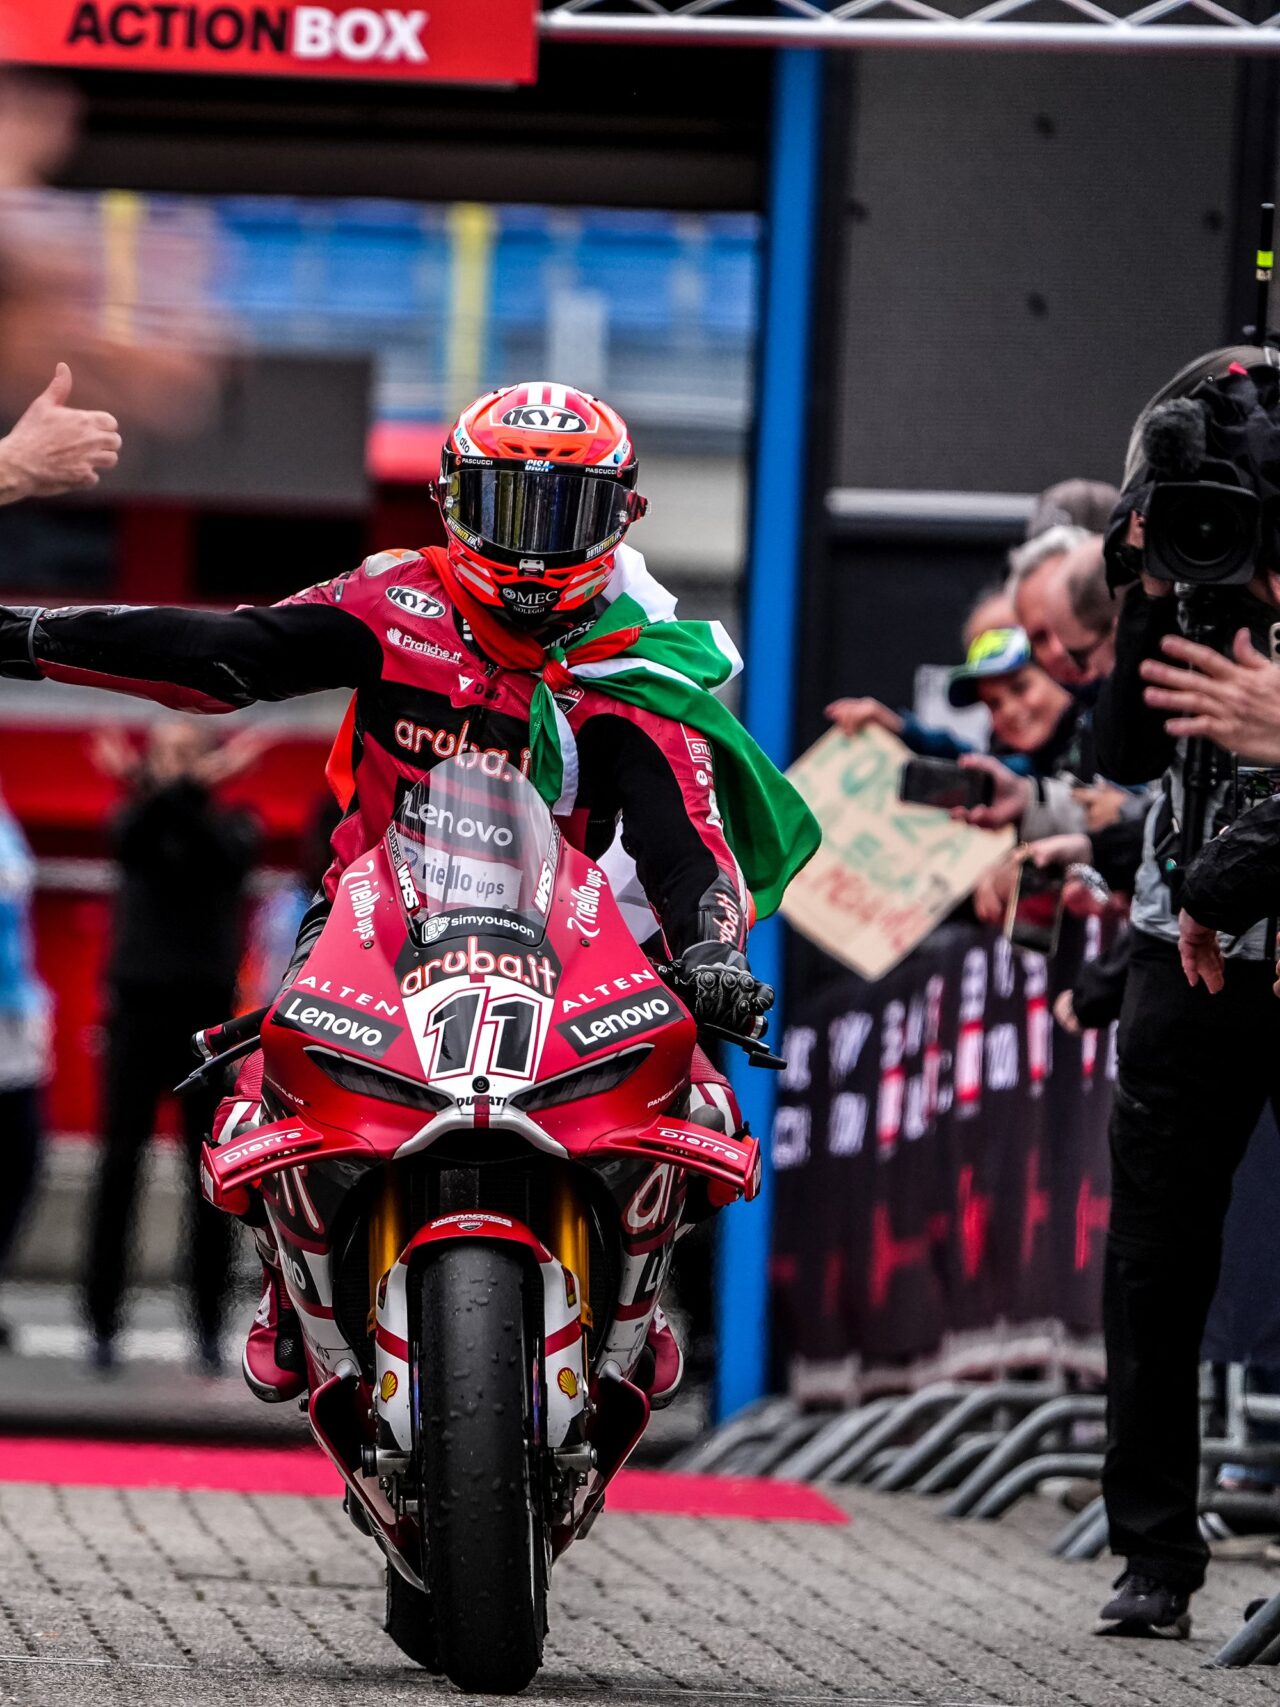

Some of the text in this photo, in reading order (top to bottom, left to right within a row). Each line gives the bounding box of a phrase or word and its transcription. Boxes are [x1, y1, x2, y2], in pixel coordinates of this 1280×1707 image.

[509, 408, 580, 430] KYT
[461, 458, 494, 466] PASCUCCI
[524, 459, 551, 472] CISA
[585, 467, 617, 475] PASCUCCI
[391, 588, 440, 613] KYT
[512, 605, 545, 615] NOLEGGI
[395, 718, 533, 784] aruba.i
[404, 790, 514, 847] Lenovo
[397, 863, 420, 909] WRS
[422, 858, 505, 902] riello ups
[534, 860, 553, 914] WRS
[570, 867, 608, 925] riello ups
[348, 880, 381, 940] riello ups
[451, 913, 535, 938] simyousoon
[400, 935, 557, 996] aruba.it
[297, 975, 400, 1016] ALTEN
[561, 969, 656, 1013] ALTEN
[284, 997, 383, 1047] Lenovo
[424, 987, 542, 1082] 11
[570, 998, 670, 1046] Lenovo
[223, 1132, 302, 1163] Dierre
[659, 1129, 739, 1161] Dierre
